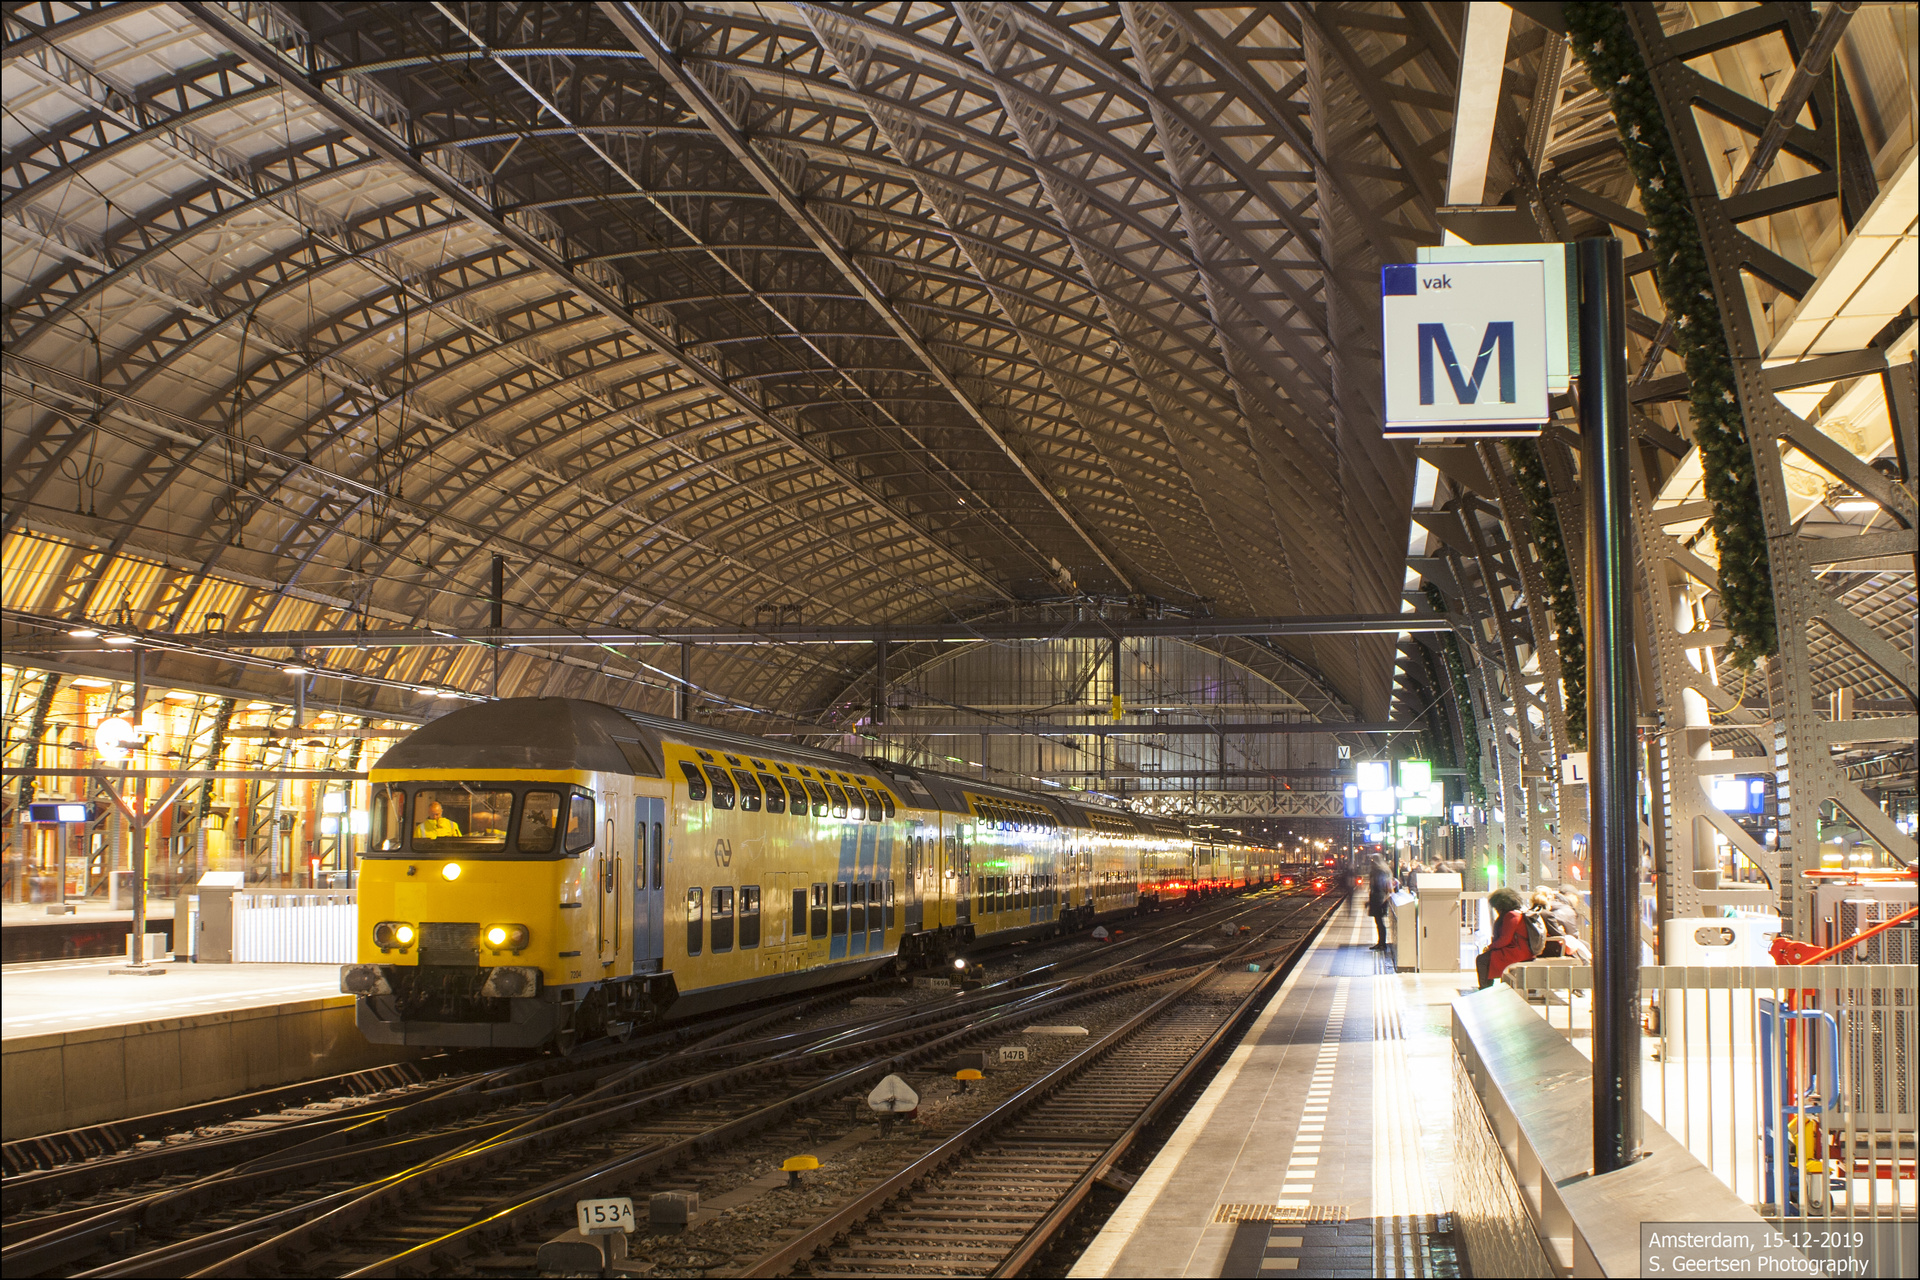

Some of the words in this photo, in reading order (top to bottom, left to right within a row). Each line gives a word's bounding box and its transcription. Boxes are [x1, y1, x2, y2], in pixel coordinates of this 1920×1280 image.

[1422, 274, 1452, 289] vak
[1417, 321, 1516, 405] M
[1340, 747, 1348, 757] V
[1572, 764, 1583, 780] L
[1003, 1050, 1025, 1060] 147B
[583, 1204, 632, 1224] 153A
